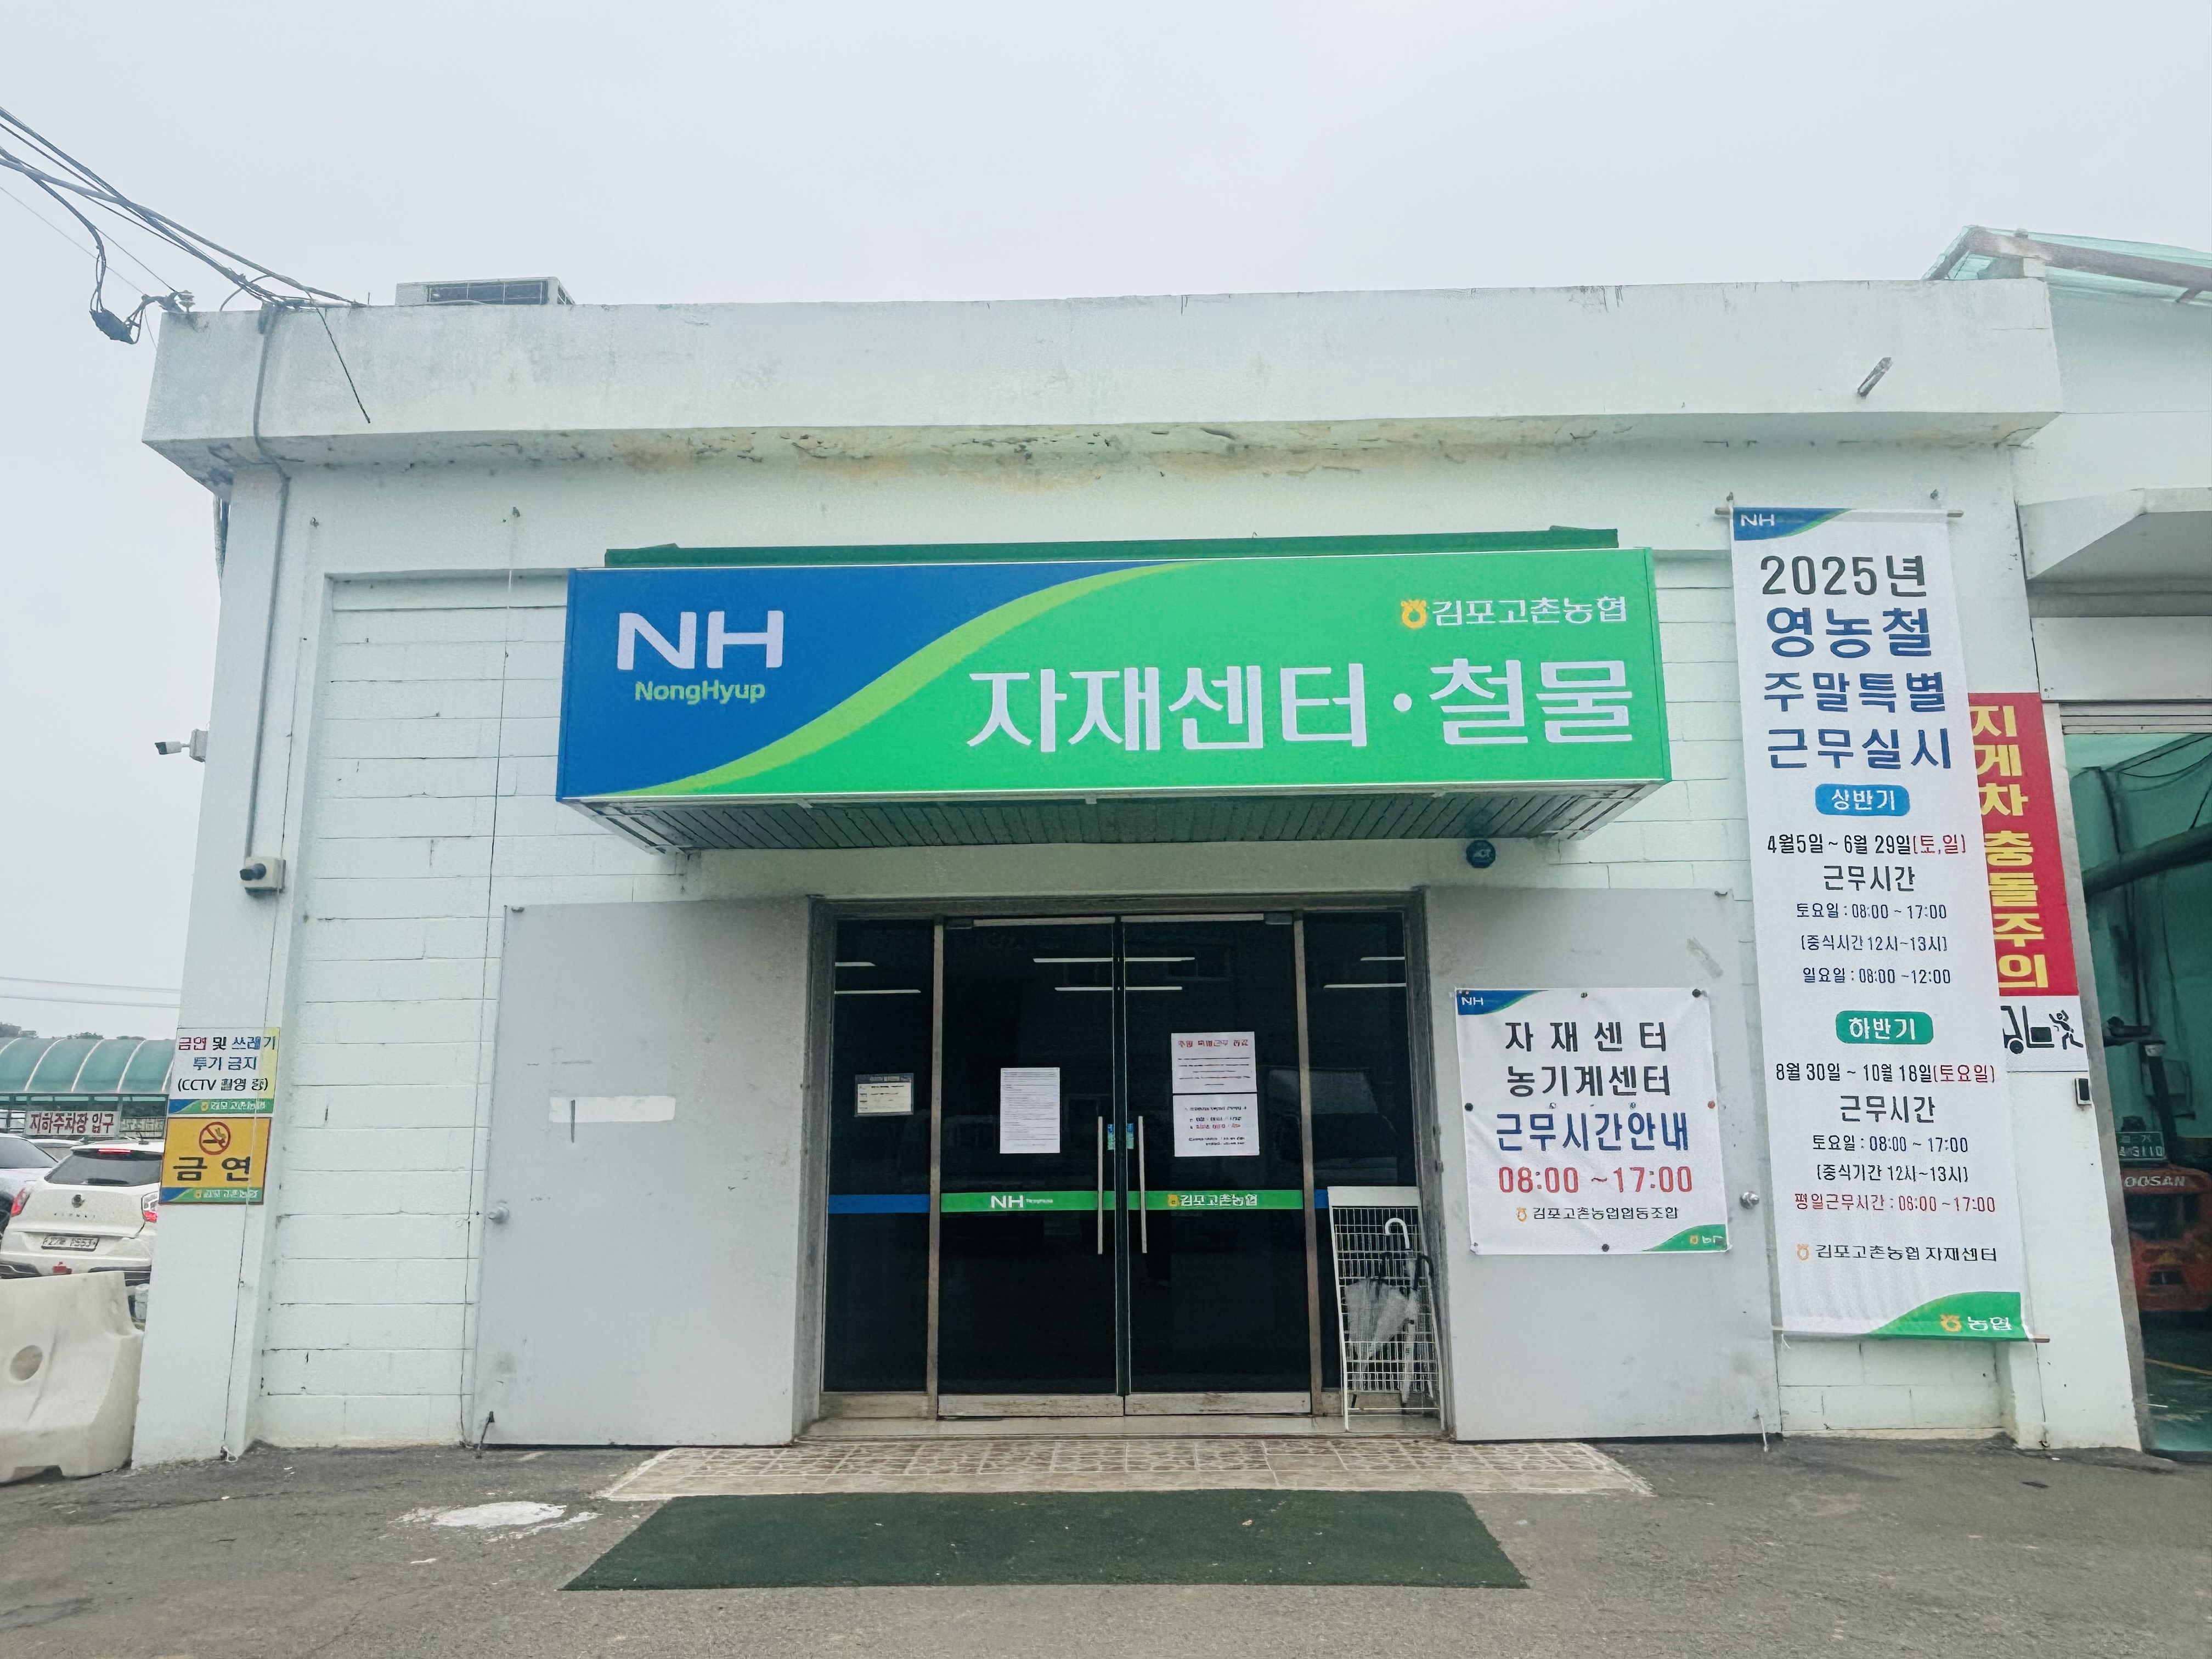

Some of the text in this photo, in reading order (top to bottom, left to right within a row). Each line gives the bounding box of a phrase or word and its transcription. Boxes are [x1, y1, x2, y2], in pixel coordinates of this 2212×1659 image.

[1740, 514, 1775, 527] NH
[1760, 555, 1927, 597] 2025년
[1432, 596, 1627, 626] 김포고촌농협
[617, 611, 784, 670] NH
[1767, 607, 1932, 658] 영농철
[635, 680, 766, 705] NongHyup
[1764, 672, 1946, 713] 주말특별
[1768, 728, 1951, 770] 근무실시
[1970, 706, 2028, 817] 지게차
[1831, 789, 1896, 811] 상반기
[1767, 833, 1823, 854] 4월5일
[1844, 834, 1867, 854] 6월
[1824, 865, 1915, 892] 근무시간
[1797, 903, 1838, 918] 토요일
[1852, 904, 1888, 919] 08:00
[1907, 905, 1947, 919] 17:00
[1803, 967, 1846, 983] 일요일
[1859, 968, 1895, 983] 08:00
[1462, 996, 1484, 1006] NH
[1849, 1017, 1915, 1041] 하반기
[178, 1036, 276, 1051] 금연 및 쓰레기
[193, 1056, 257, 1070] 투기 금지
[1776, 1062, 1801, 1081] 8월
[1807, 1063, 1841, 1082] 30일
[1863, 1063, 1893, 1082] 10월
[178, 1079, 217, 1091] (CCTV
[1507, 1065, 1671, 1097] 농기계센터
[1840, 1095, 1936, 1124] 근무시간
[29, 1112, 88, 1134] 지하주차장
[92, 1113, 114, 1134] 입구
[1496, 1111, 1689, 1152] 근무시간안내
[1813, 1135, 1855, 1151] 토요일
[1869, 1136, 1907, 1152] 08:00
[1928, 1137, 1968, 1153] 17:00
[1499, 1166, 1579, 1193] 08:00
[991, 1194, 1024, 1209] NH
[1795, 1193, 1884, 1211] 평일근무시간
[1533, 1206, 1678, 1220] 김포고촌농업협동조합
[1815, 1244, 1997, 1262] 김포고촌농협 자재센터
[1967, 1316, 2012, 1331] 농협
